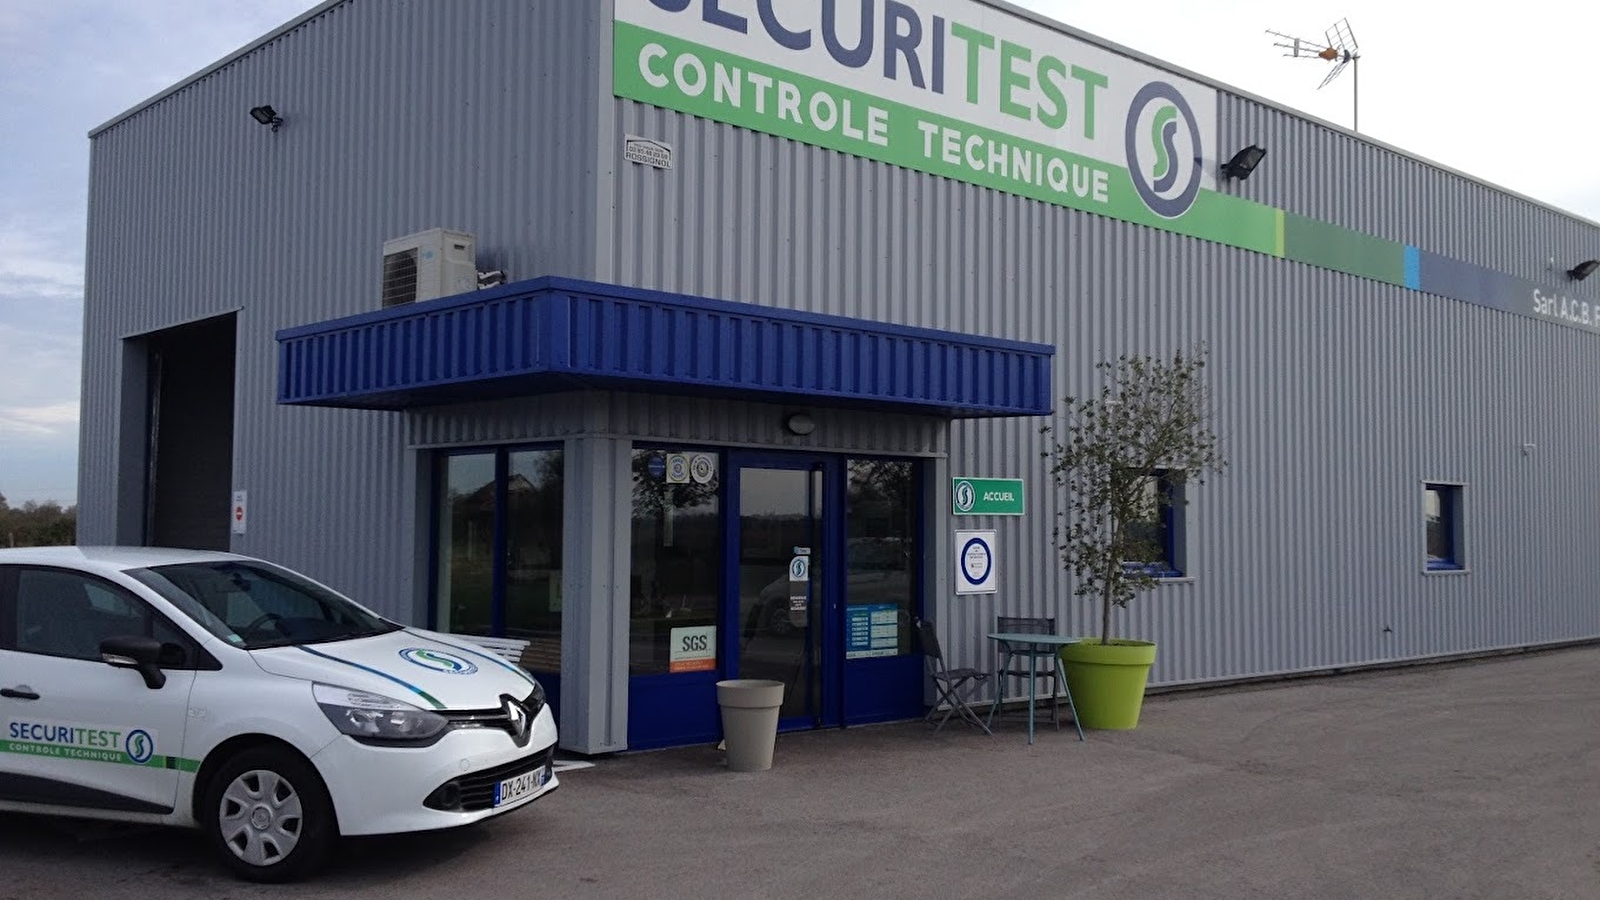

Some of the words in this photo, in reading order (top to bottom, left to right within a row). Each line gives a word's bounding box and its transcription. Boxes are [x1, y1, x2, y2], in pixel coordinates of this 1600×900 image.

[648, 0, 1108, 140] CURITEST
[638, 43, 889, 148] CONTROLE
[918, 120, 1109, 203] TECHNIQUE
[625, 151, 671, 168] ROSSIGNOL
[1533, 289, 1558, 317] Sarl
[983, 491, 1015, 502] ACCUEIL
[682, 634, 708, 652] SGS
[9, 722, 122, 748] SECURITEST
[9, 742, 62, 756] CONTROLE
[63, 748, 122, 762] TECHNIQUE
